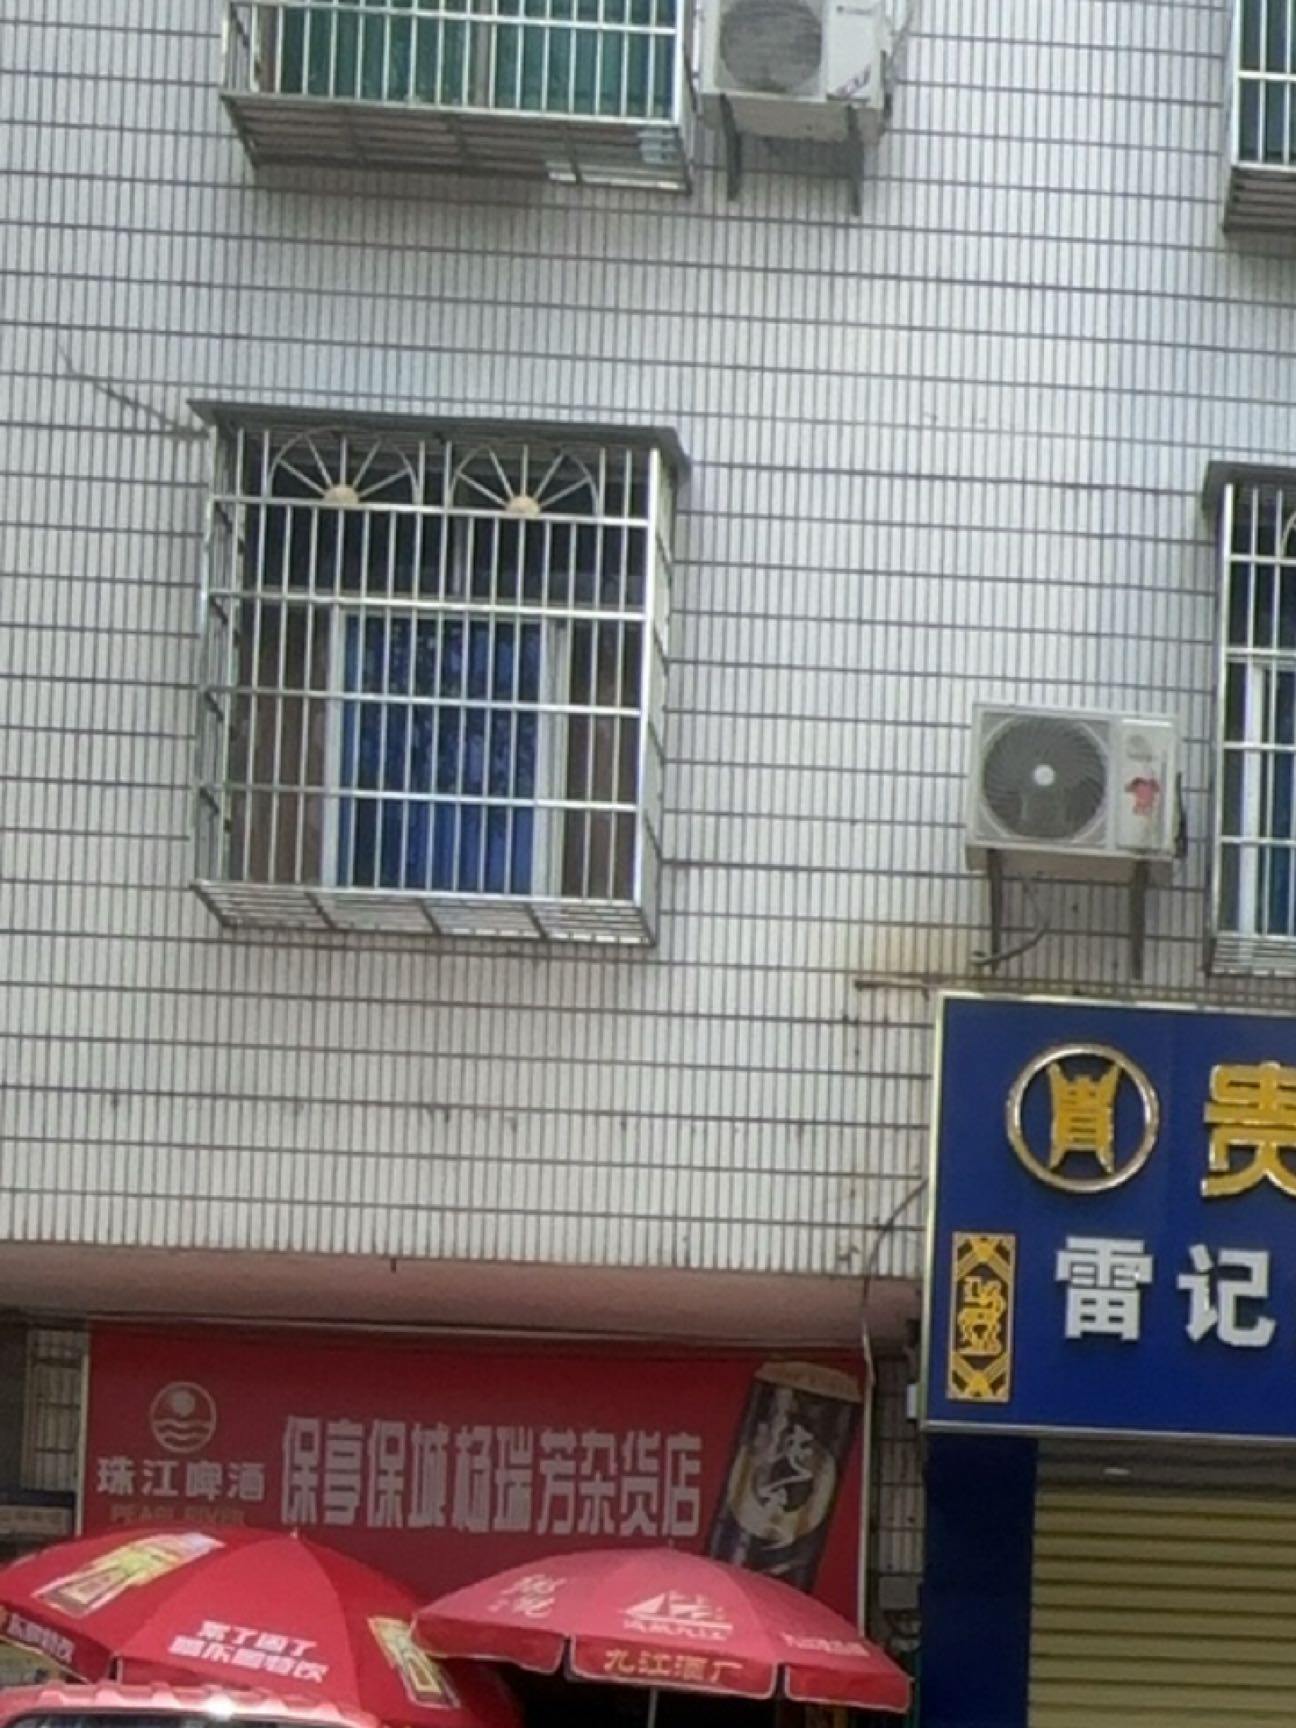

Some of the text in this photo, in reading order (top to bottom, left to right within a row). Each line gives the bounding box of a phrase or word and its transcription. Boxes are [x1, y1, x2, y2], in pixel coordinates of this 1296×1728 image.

[96, 1455, 266, 1503] 珠江啤酒
[603, 1647, 745, 1685] 九江酒厂
